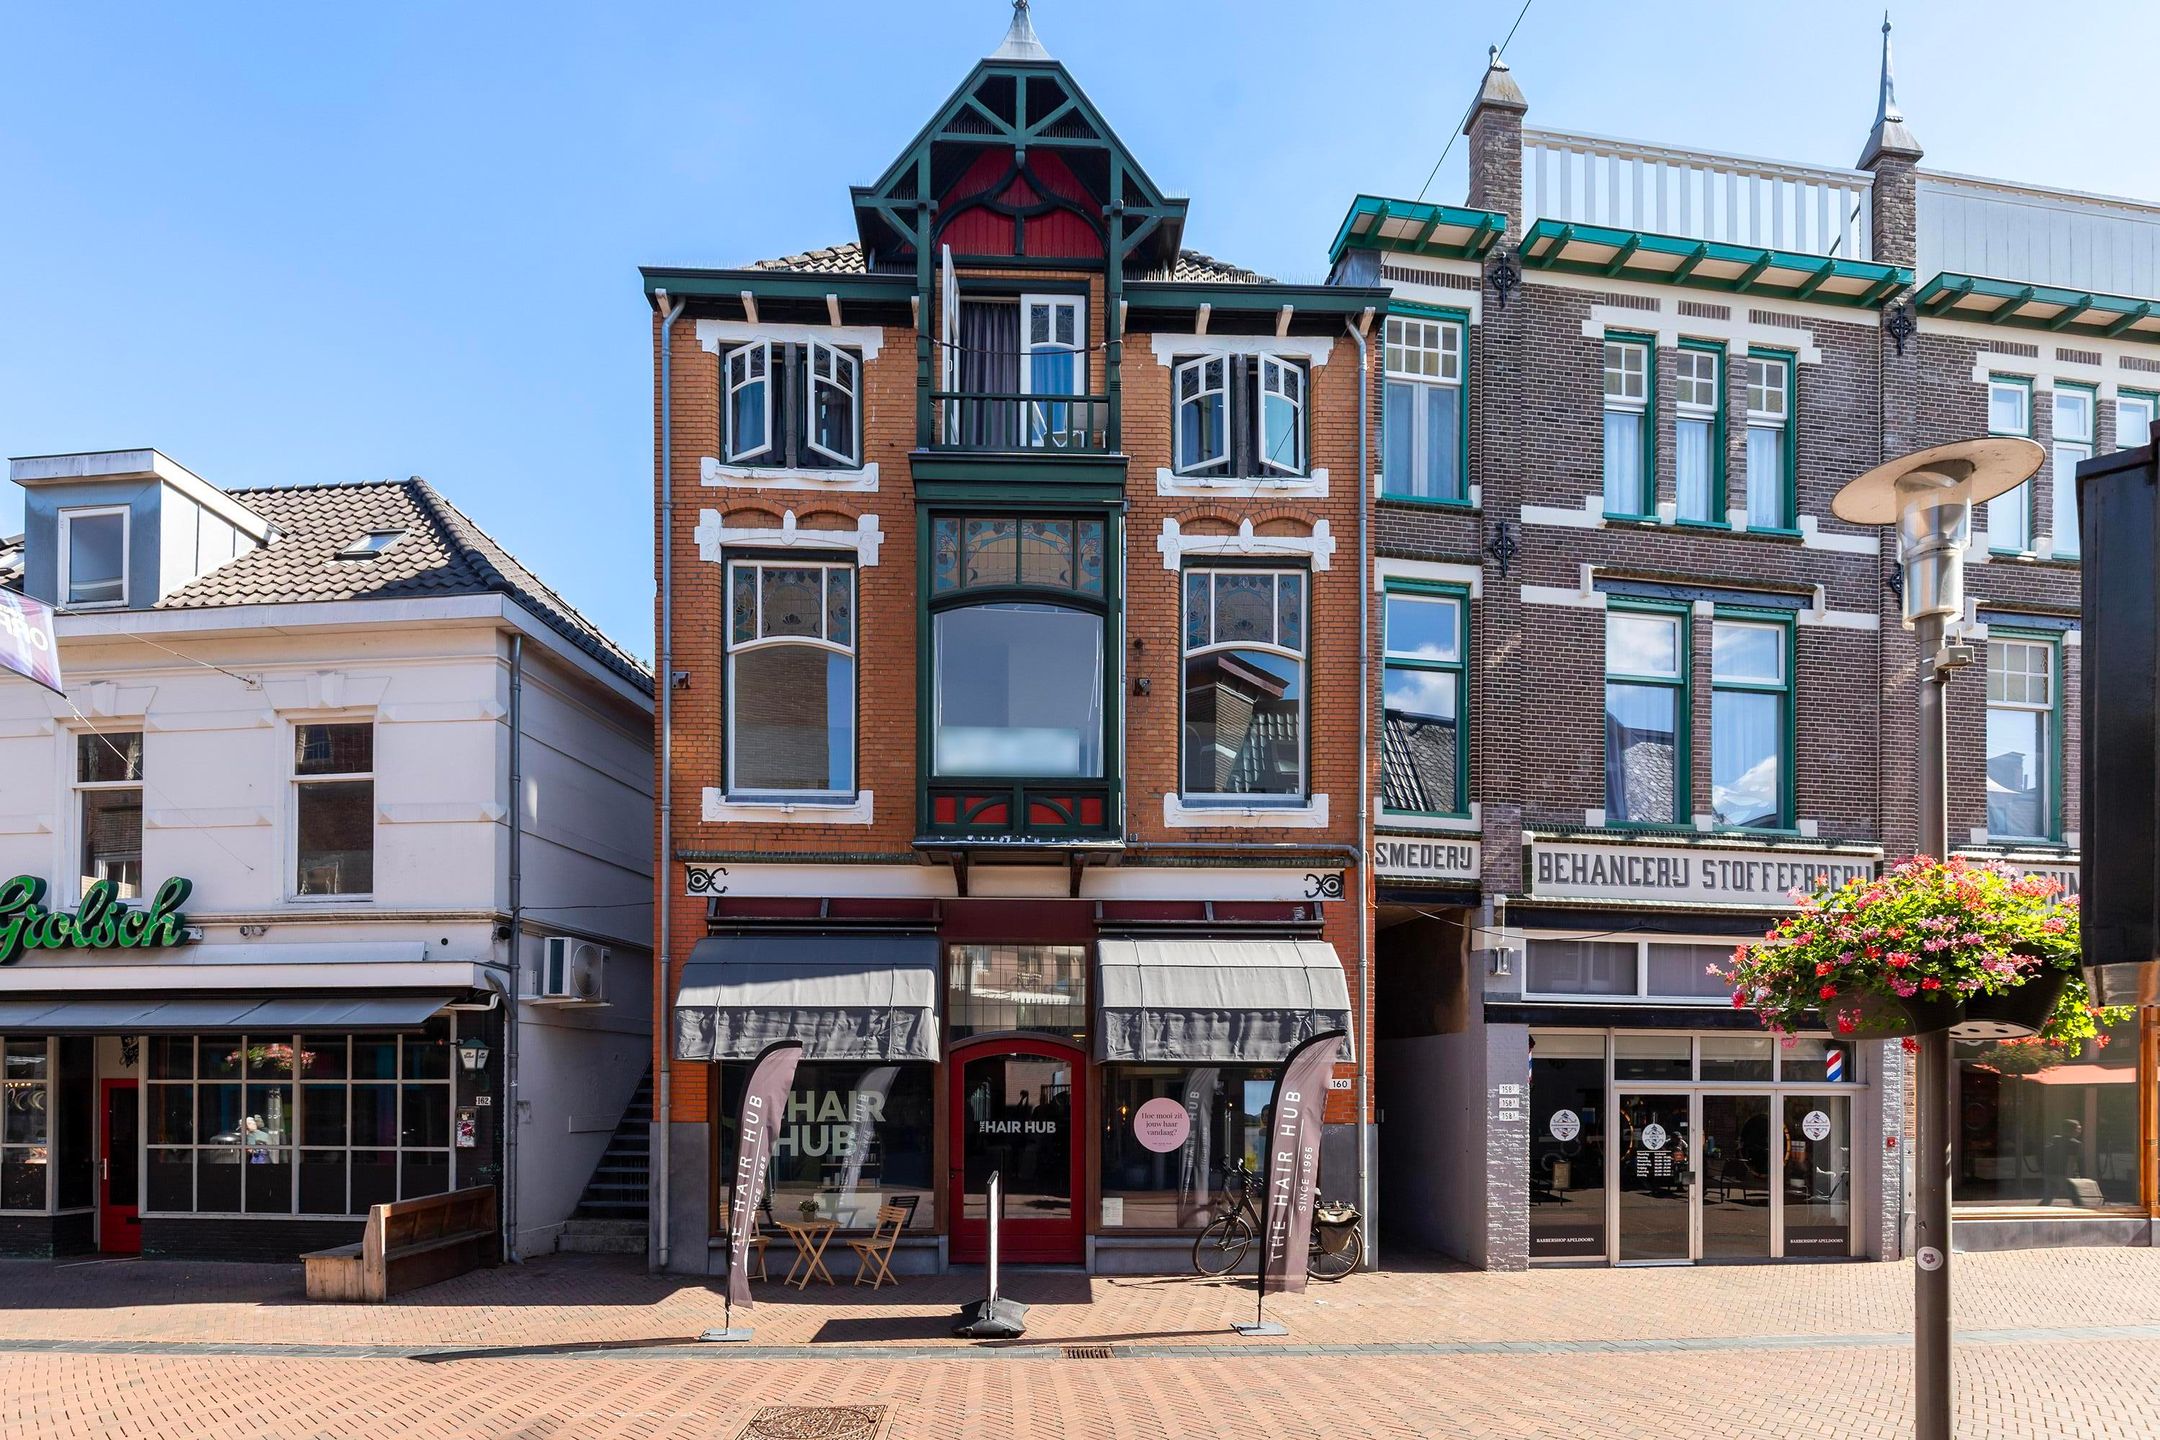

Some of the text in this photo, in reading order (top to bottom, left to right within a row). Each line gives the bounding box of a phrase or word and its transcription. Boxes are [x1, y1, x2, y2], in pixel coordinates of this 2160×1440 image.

[1375, 842, 1472, 870] SMEDERIJ
[0, 875, 190, 965] Grolsch
[1332, 1080, 1348, 1088] 160
[477, 1097, 490, 1105] 162
[787, 1090, 886, 1122] HAIR
[771, 1125, 857, 1157] HUB
[985, 1120, 1021, 1133] HAIR
[1024, 1121, 1057, 1133] HUB
[734, 1156, 752, 1213] HAIR
[743, 1094, 763, 1143] HUB
[1271, 1091, 1301, 1262] THE HAIR HUB
[1298, 1146, 1313, 1212] SINCE 1965
